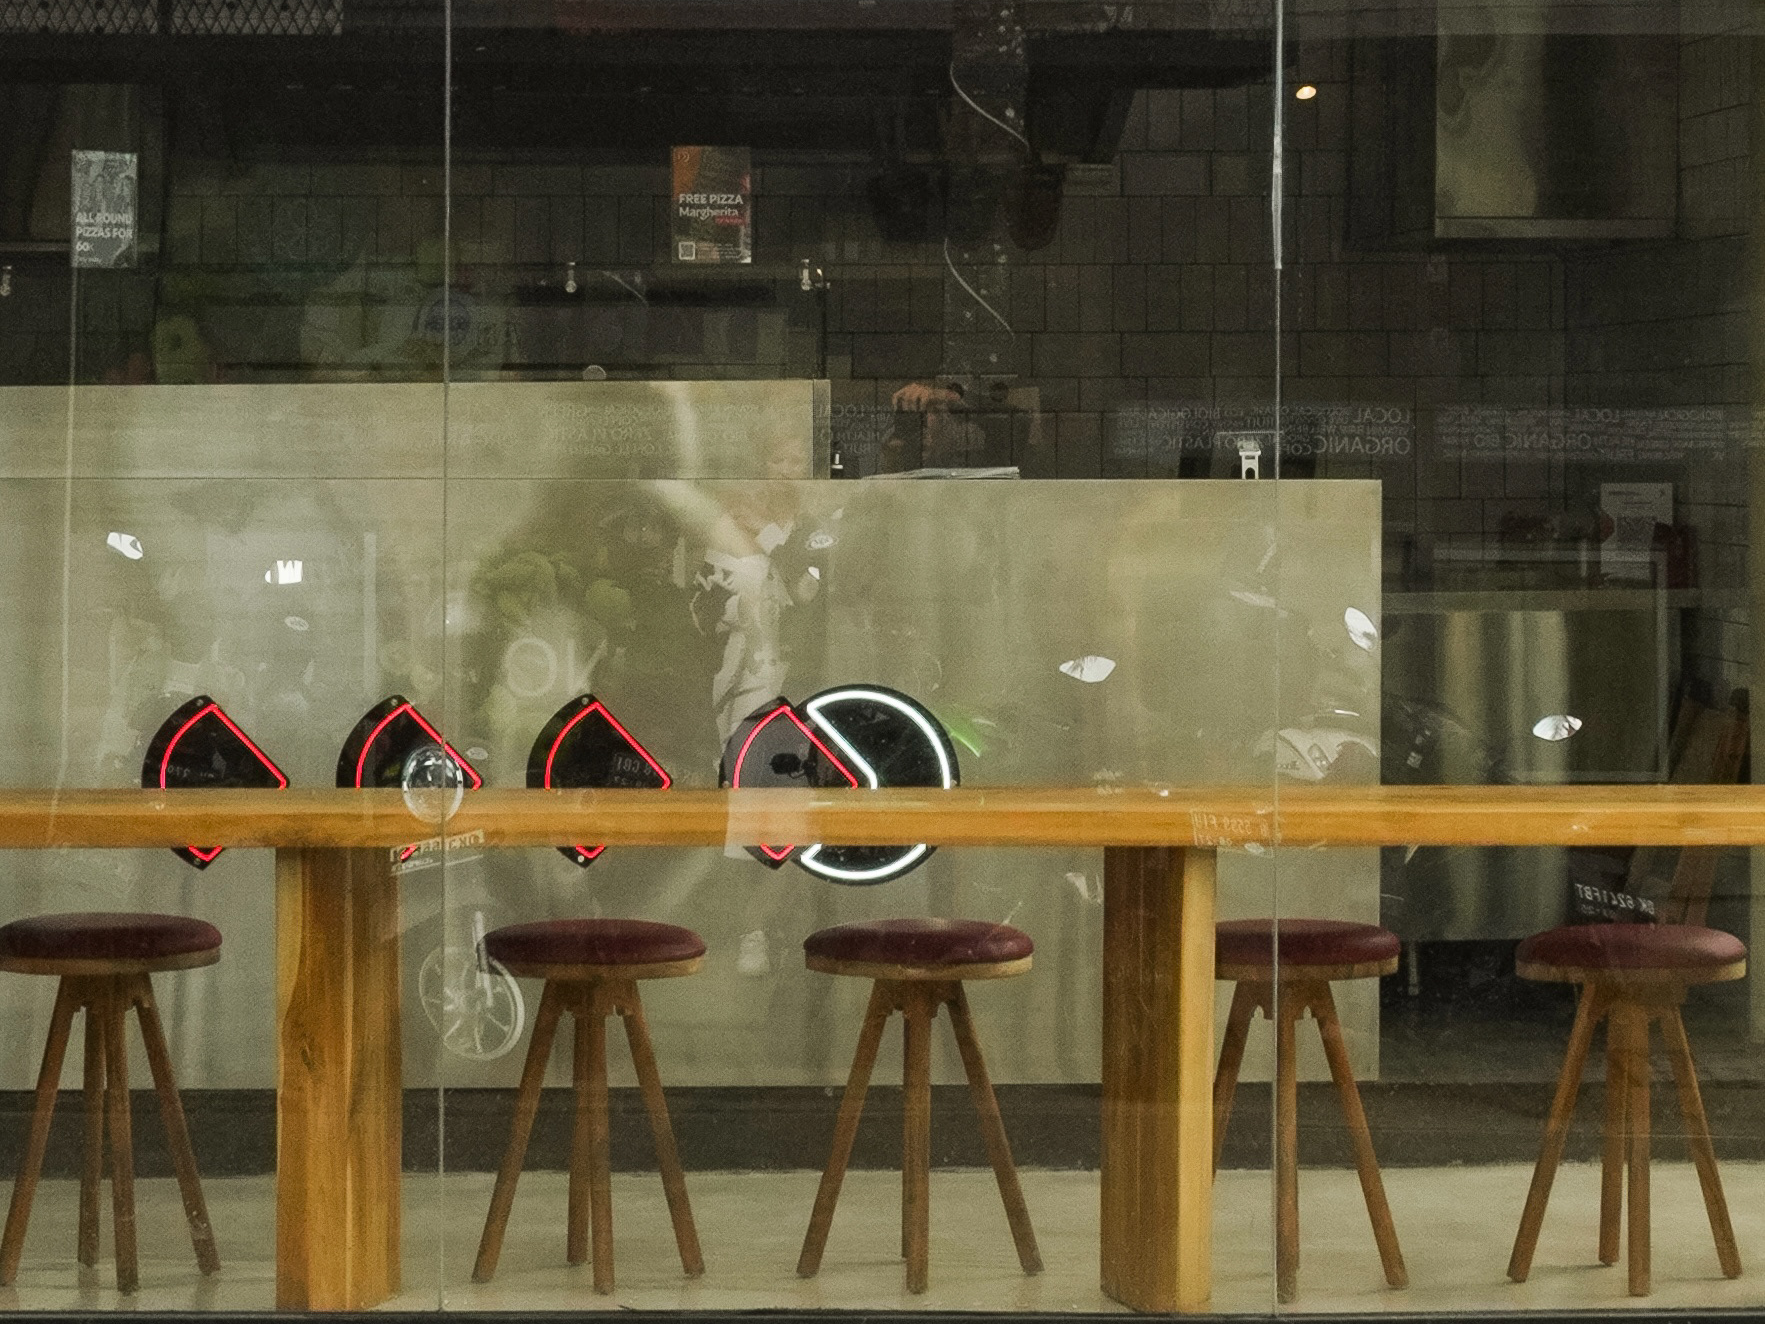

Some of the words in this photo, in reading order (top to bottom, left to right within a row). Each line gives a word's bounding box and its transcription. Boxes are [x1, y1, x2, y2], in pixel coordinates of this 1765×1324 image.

[679, 193, 708, 205] FREE
[709, 193, 744, 205] PIZZA
[679, 206, 740, 221] Margherita
[76, 226, 112, 238] PIZZAS
